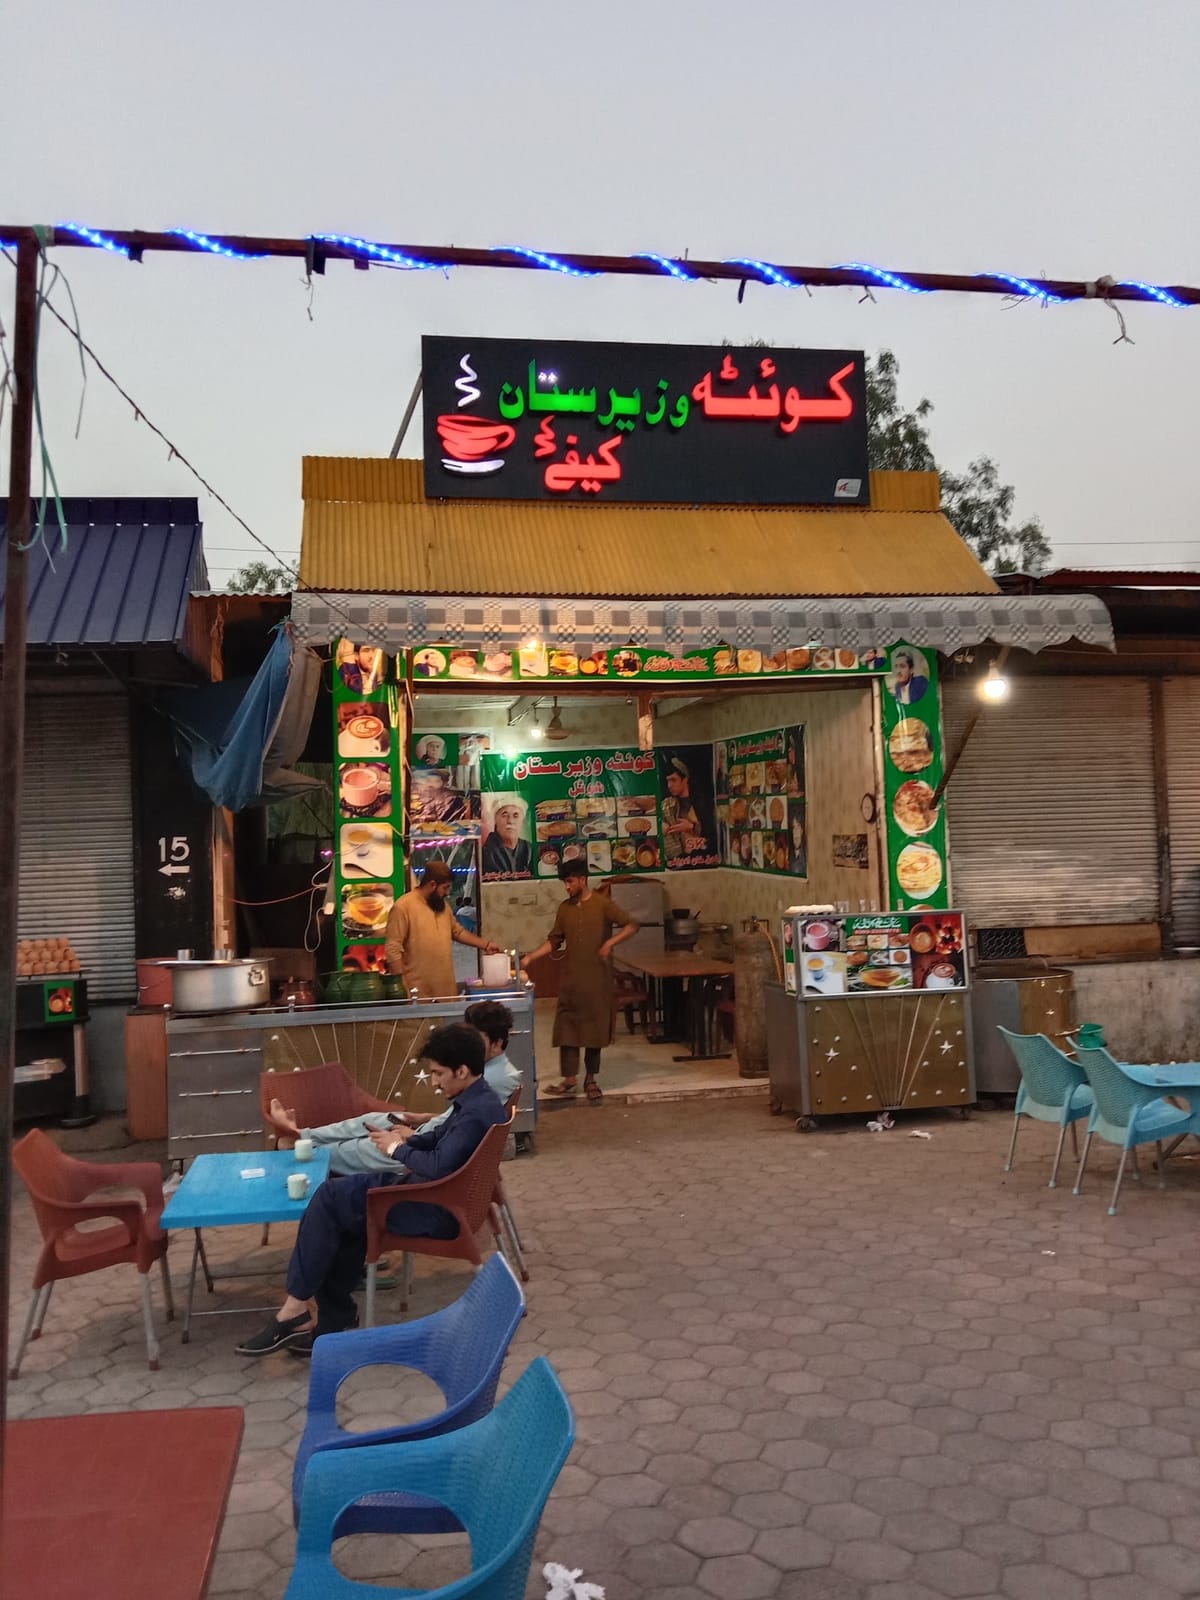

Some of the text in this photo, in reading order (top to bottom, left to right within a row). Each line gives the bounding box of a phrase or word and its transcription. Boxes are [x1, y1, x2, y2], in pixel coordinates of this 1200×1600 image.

[692, 354, 856, 433] کوئٹہ
[605, 751, 656, 774] کوئٹہ
[158, 836, 190, 862] 15
